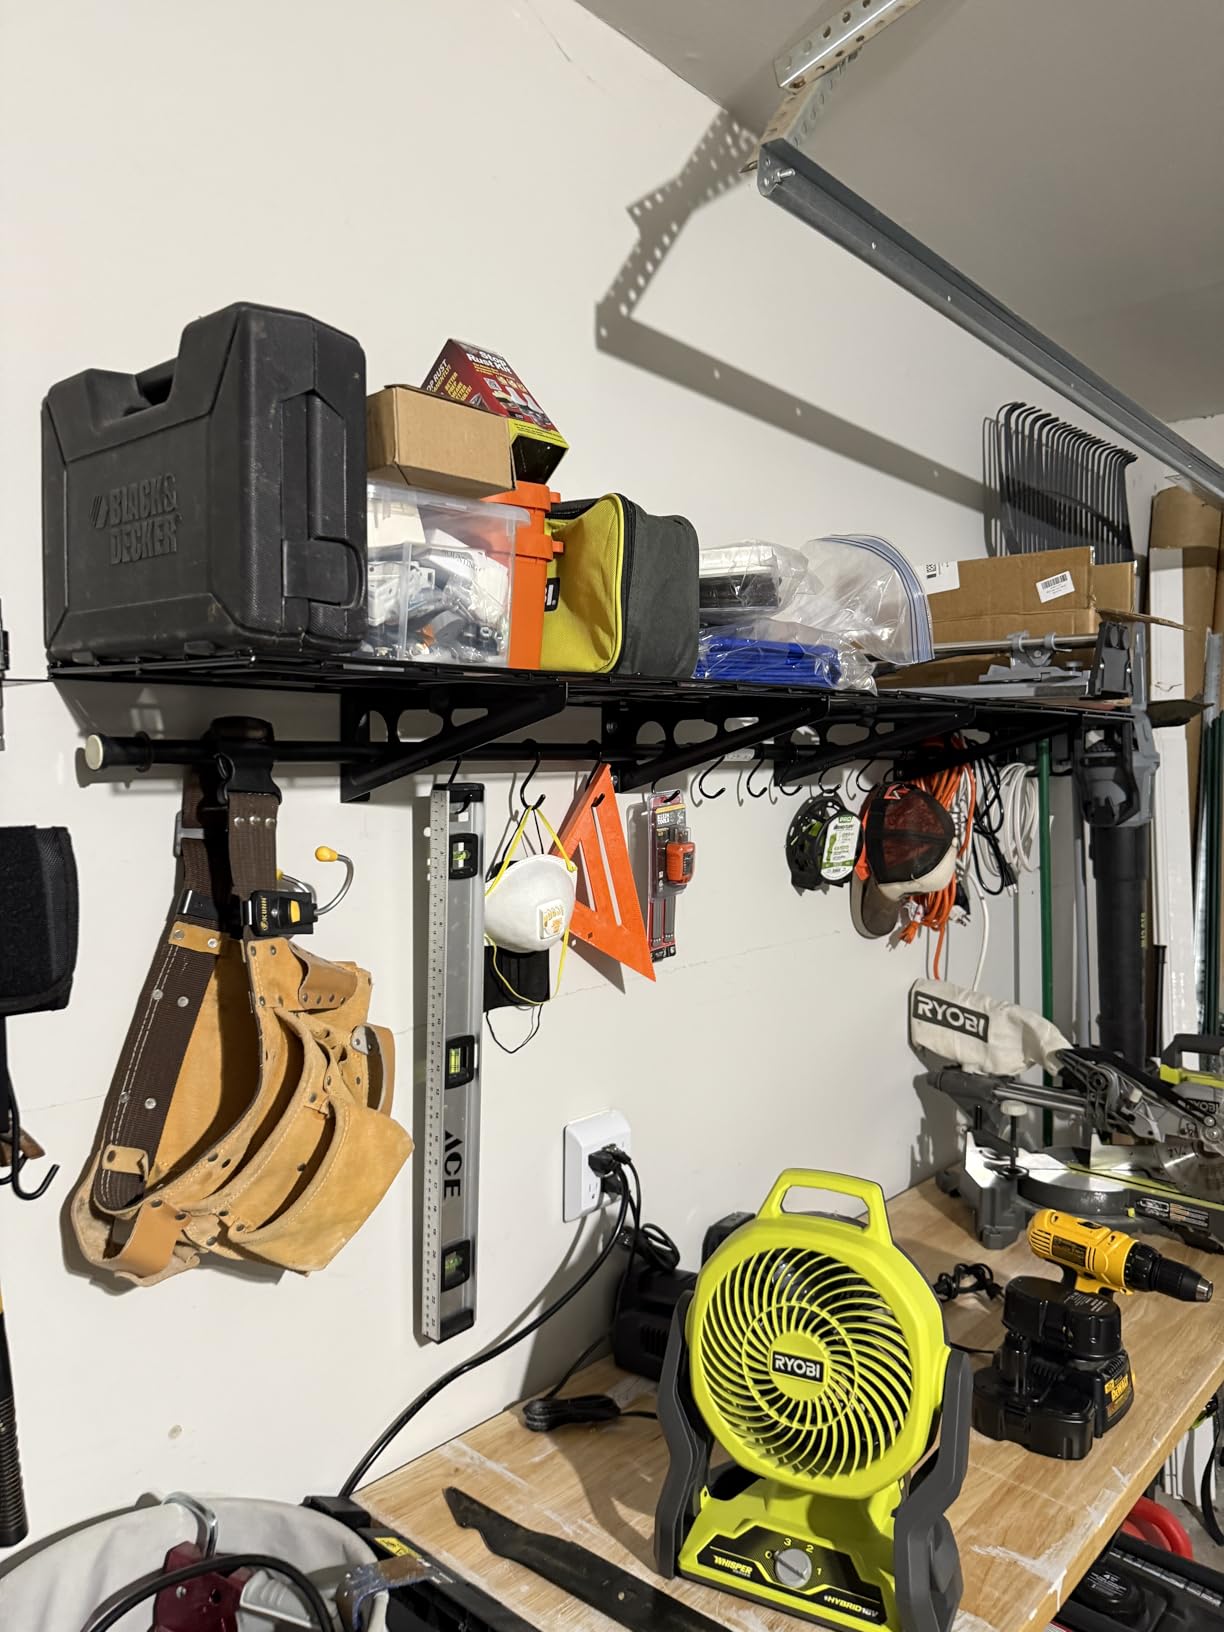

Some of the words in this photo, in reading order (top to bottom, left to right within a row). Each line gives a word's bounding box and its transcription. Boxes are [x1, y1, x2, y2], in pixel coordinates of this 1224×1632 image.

[433, 358, 448, 382] RUST
[467, 353, 494, 367] Rust
[494, 362, 512, 374] Kit
[110, 518, 178, 565] DECKER
[917, 995, 986, 1037] RYOBI
[444, 1129, 463, 1200] ACE
[774, 1353, 821, 1379] RYOBI
[783, 1537, 792, 1547] 3
[805, 1544, 814, 1553] 2
[713, 1555, 753, 1575] WHISPER
[816, 1567, 823, 1576] 1
